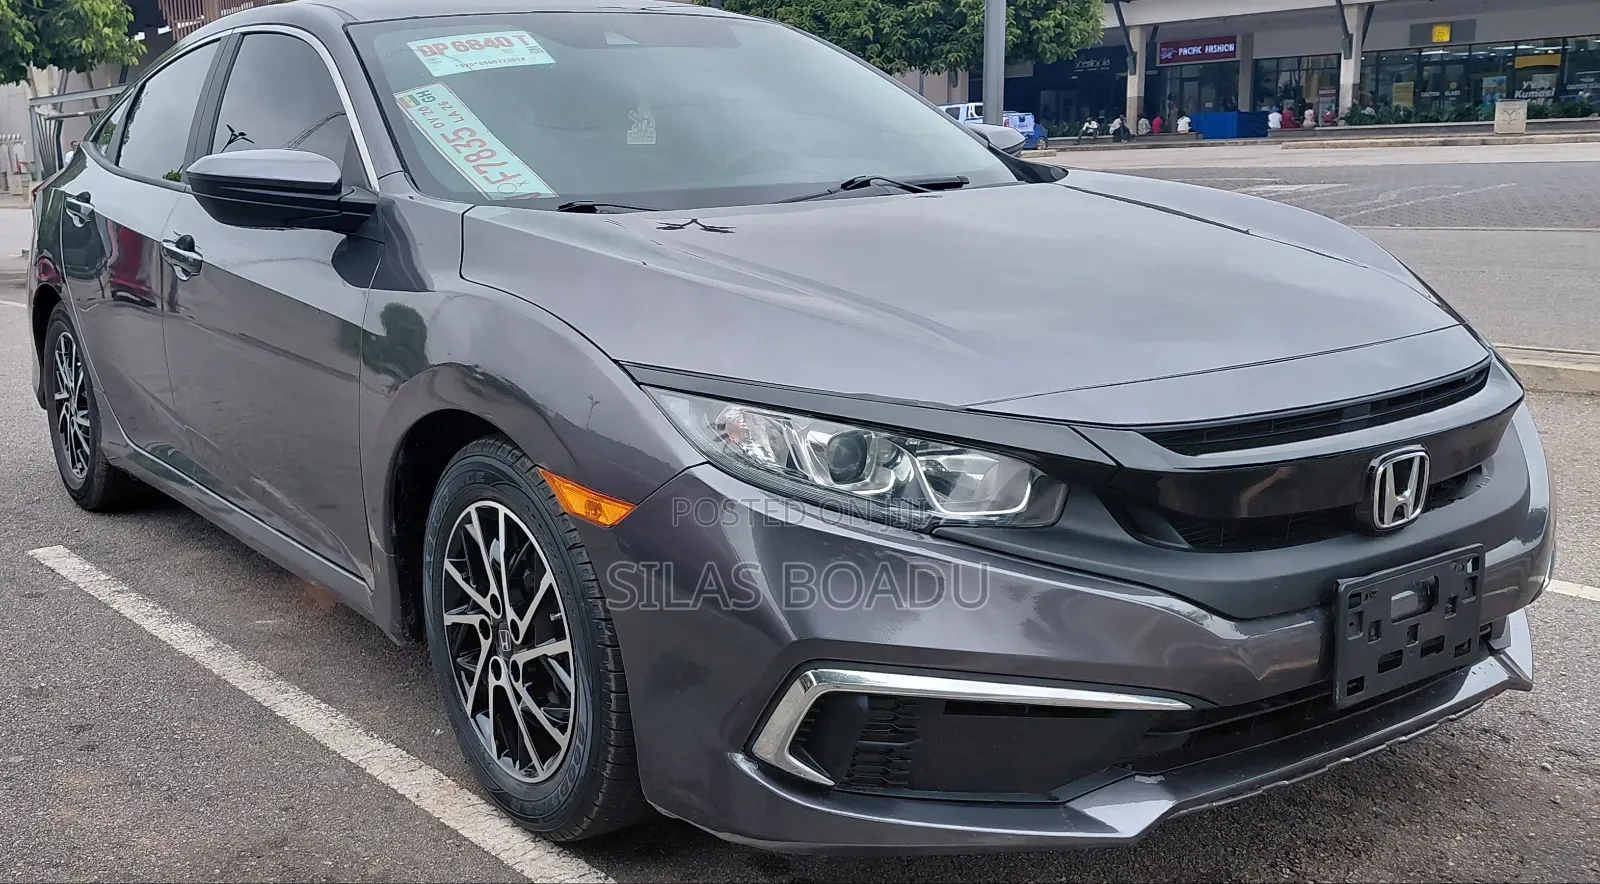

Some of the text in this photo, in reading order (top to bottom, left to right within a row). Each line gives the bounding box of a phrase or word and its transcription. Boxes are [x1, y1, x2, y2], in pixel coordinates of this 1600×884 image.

[450, 37, 515, 52] 6840
[511, 34, 530, 46] T
[1178, 43, 1235, 56] PACIFIC FASHION
[415, 89, 437, 103] GH
[424, 470, 486, 580] ASSURCE
